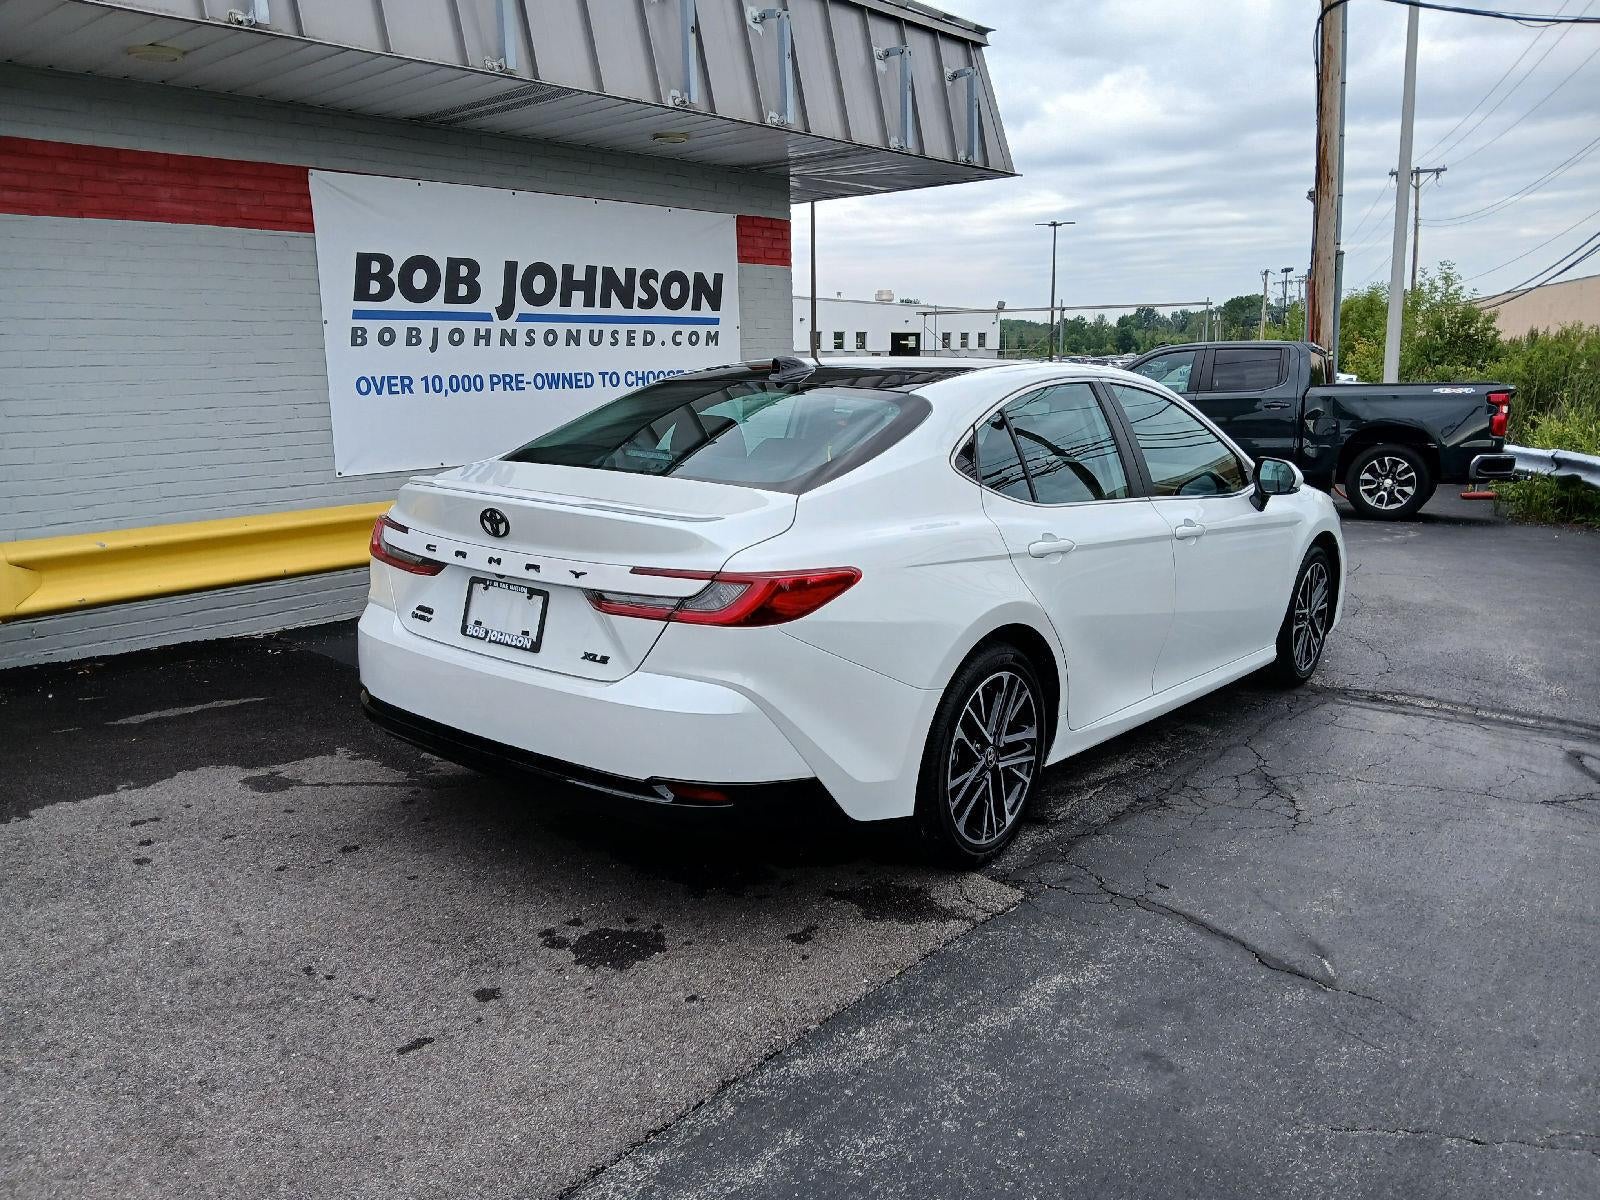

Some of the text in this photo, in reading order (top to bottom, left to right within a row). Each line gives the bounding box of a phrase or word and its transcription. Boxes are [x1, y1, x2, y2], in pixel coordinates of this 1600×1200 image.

[353, 252, 724, 321] BOB JOHNSON
[350, 326, 719, 353] BOBJOHNSONUSED.COM
[355, 375, 414, 396] OVER
[420, 373, 484, 398] 10,000
[489, 371, 595, 392] PRE-OWNED
[599, 371, 621, 388] TO
[425, 543, 588, 579] CAMRY
[466, 624, 532, 649] BOB JOHNSON
[580, 651, 610, 664] XLE
